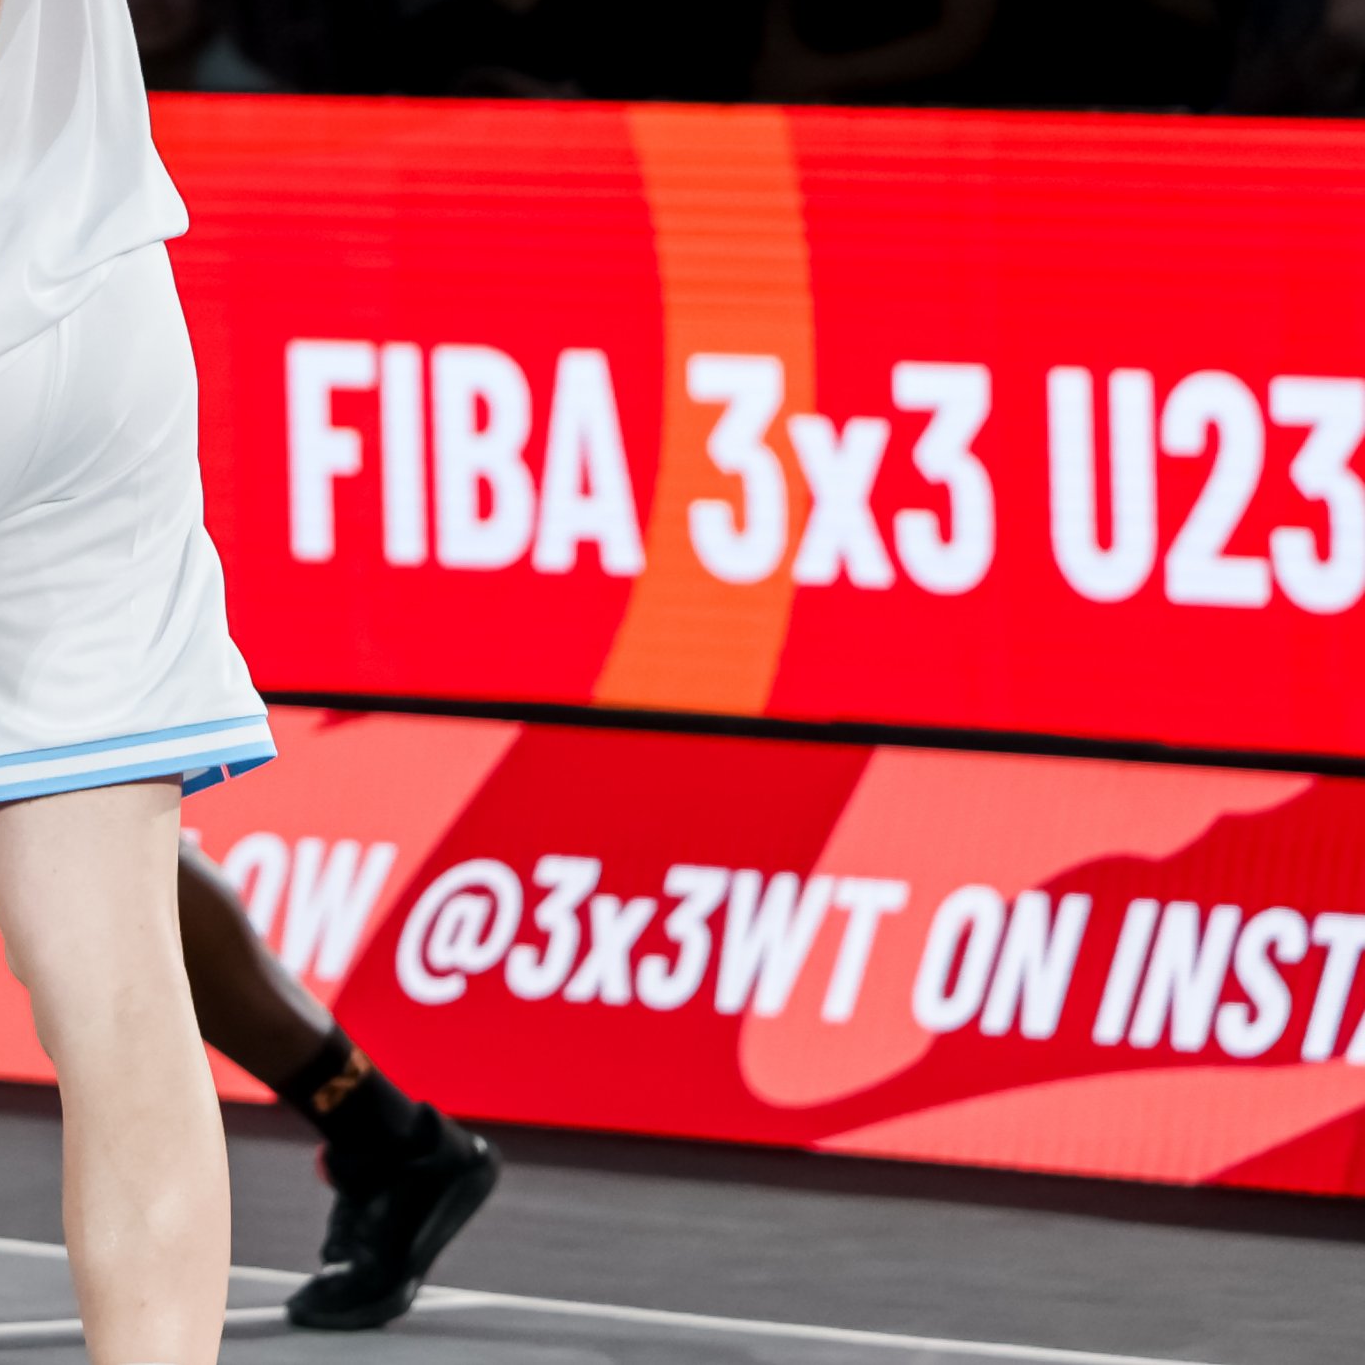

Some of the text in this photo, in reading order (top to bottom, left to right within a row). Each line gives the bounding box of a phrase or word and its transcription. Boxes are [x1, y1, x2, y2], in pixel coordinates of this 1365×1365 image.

[284, 337, 1365, 616] FIBA 3x3 U23
[394, 854, 910, 1024] @3x3WT
[911, 883, 1093, 1041] ON
[1090, 896, 1365, 1066] INST
